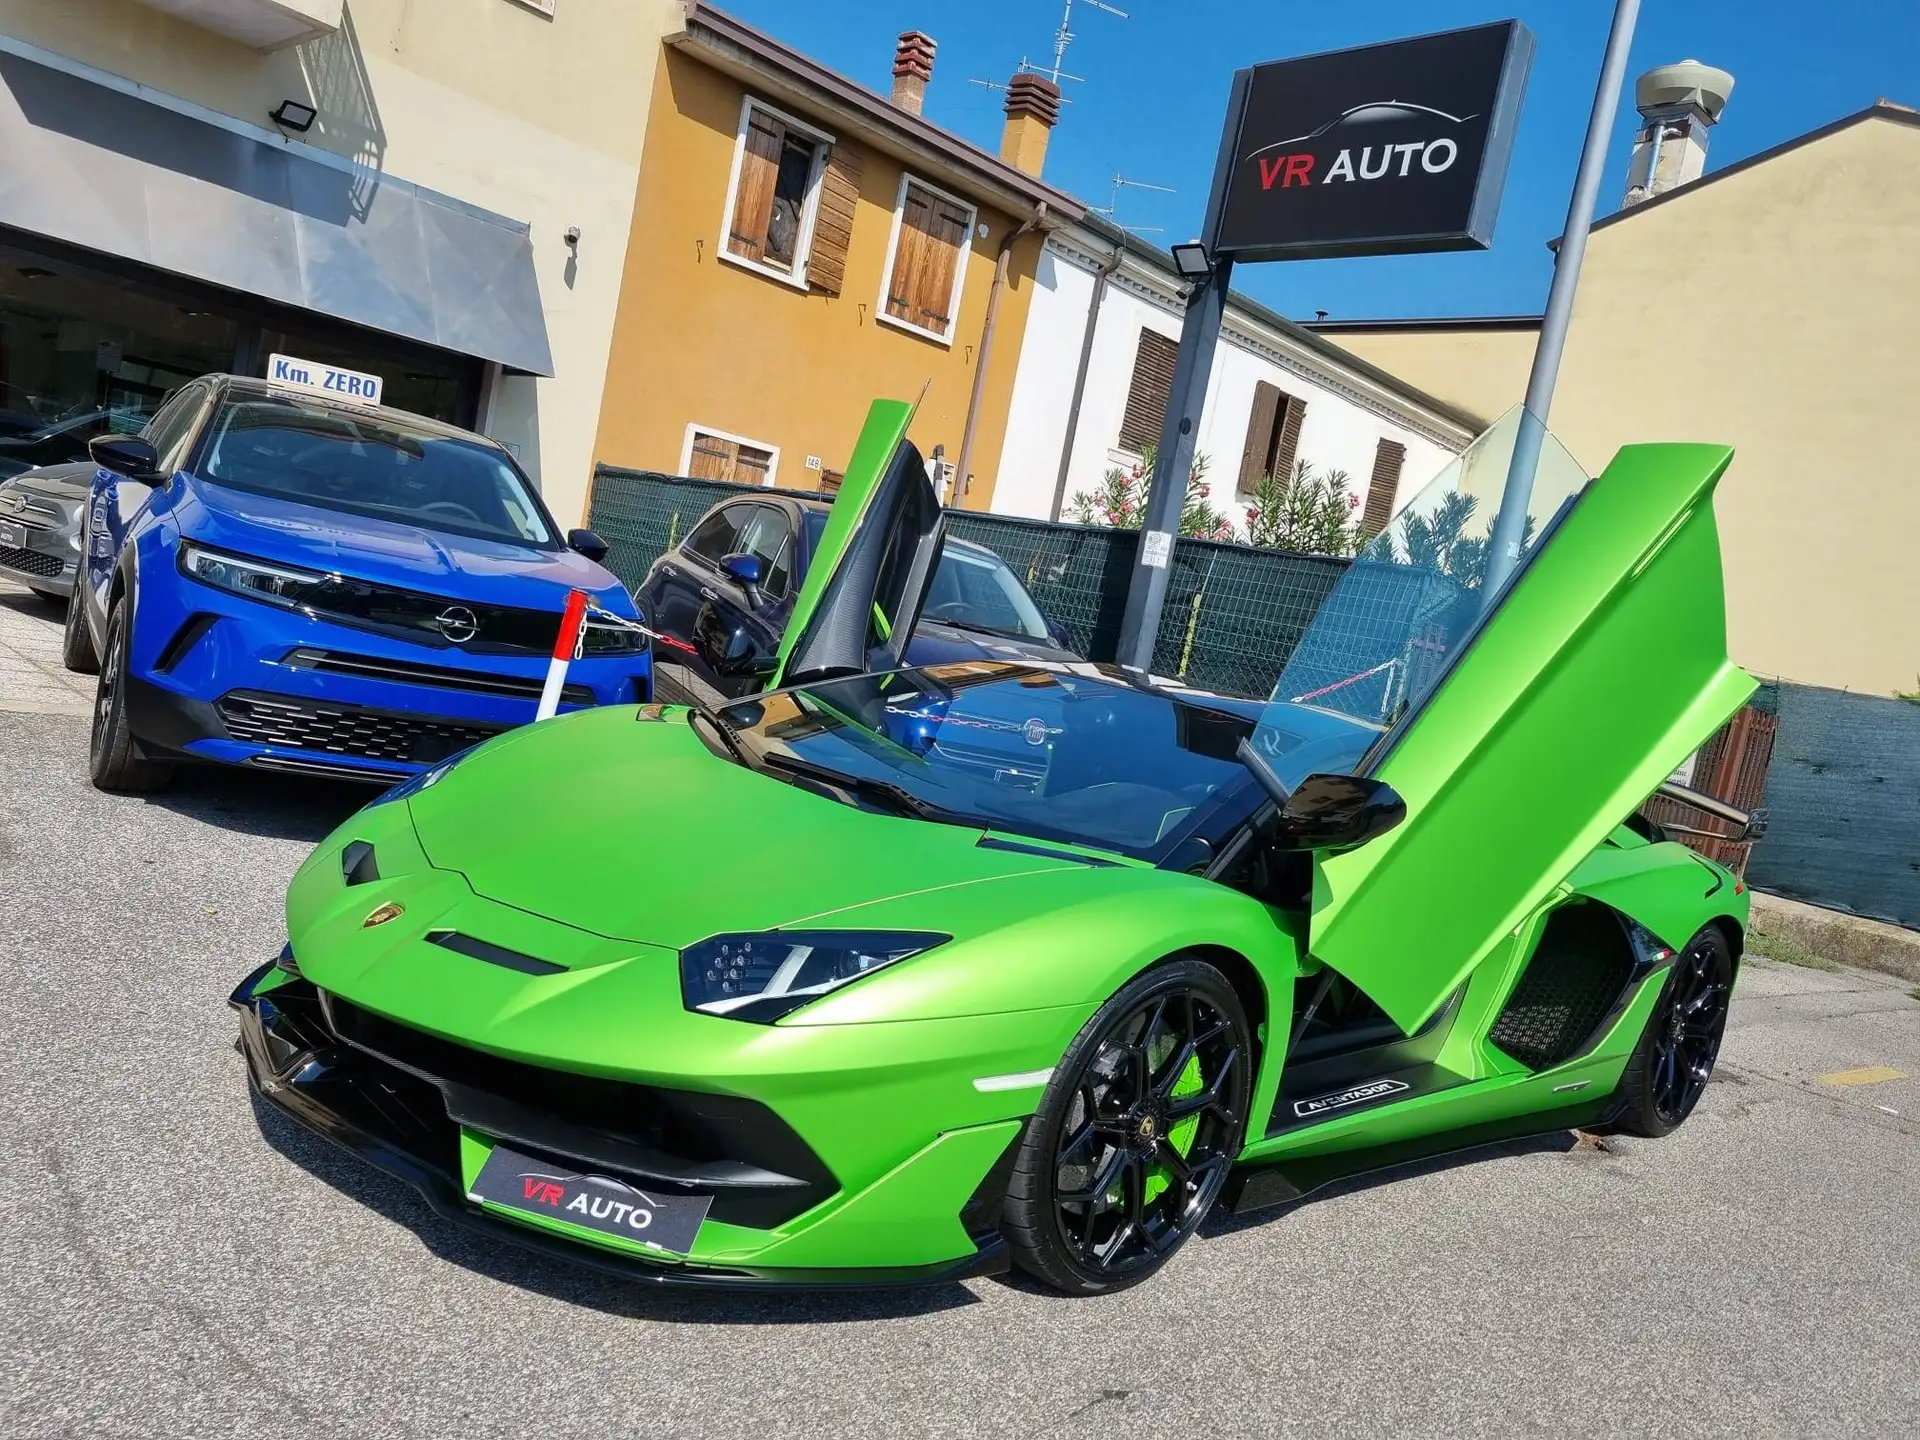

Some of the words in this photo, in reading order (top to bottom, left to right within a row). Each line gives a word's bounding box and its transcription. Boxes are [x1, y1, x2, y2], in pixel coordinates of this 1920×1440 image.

[1258, 153, 1315, 190] VR
[1322, 138, 1457, 184] AUTO
[275, 360, 315, 386] Km.
[323, 370, 376, 398] ZERO
[1308, 1083, 1393, 1110] AVENTADOR
[523, 1176, 565, 1207] VR
[566, 1193, 652, 1229] AUTO
